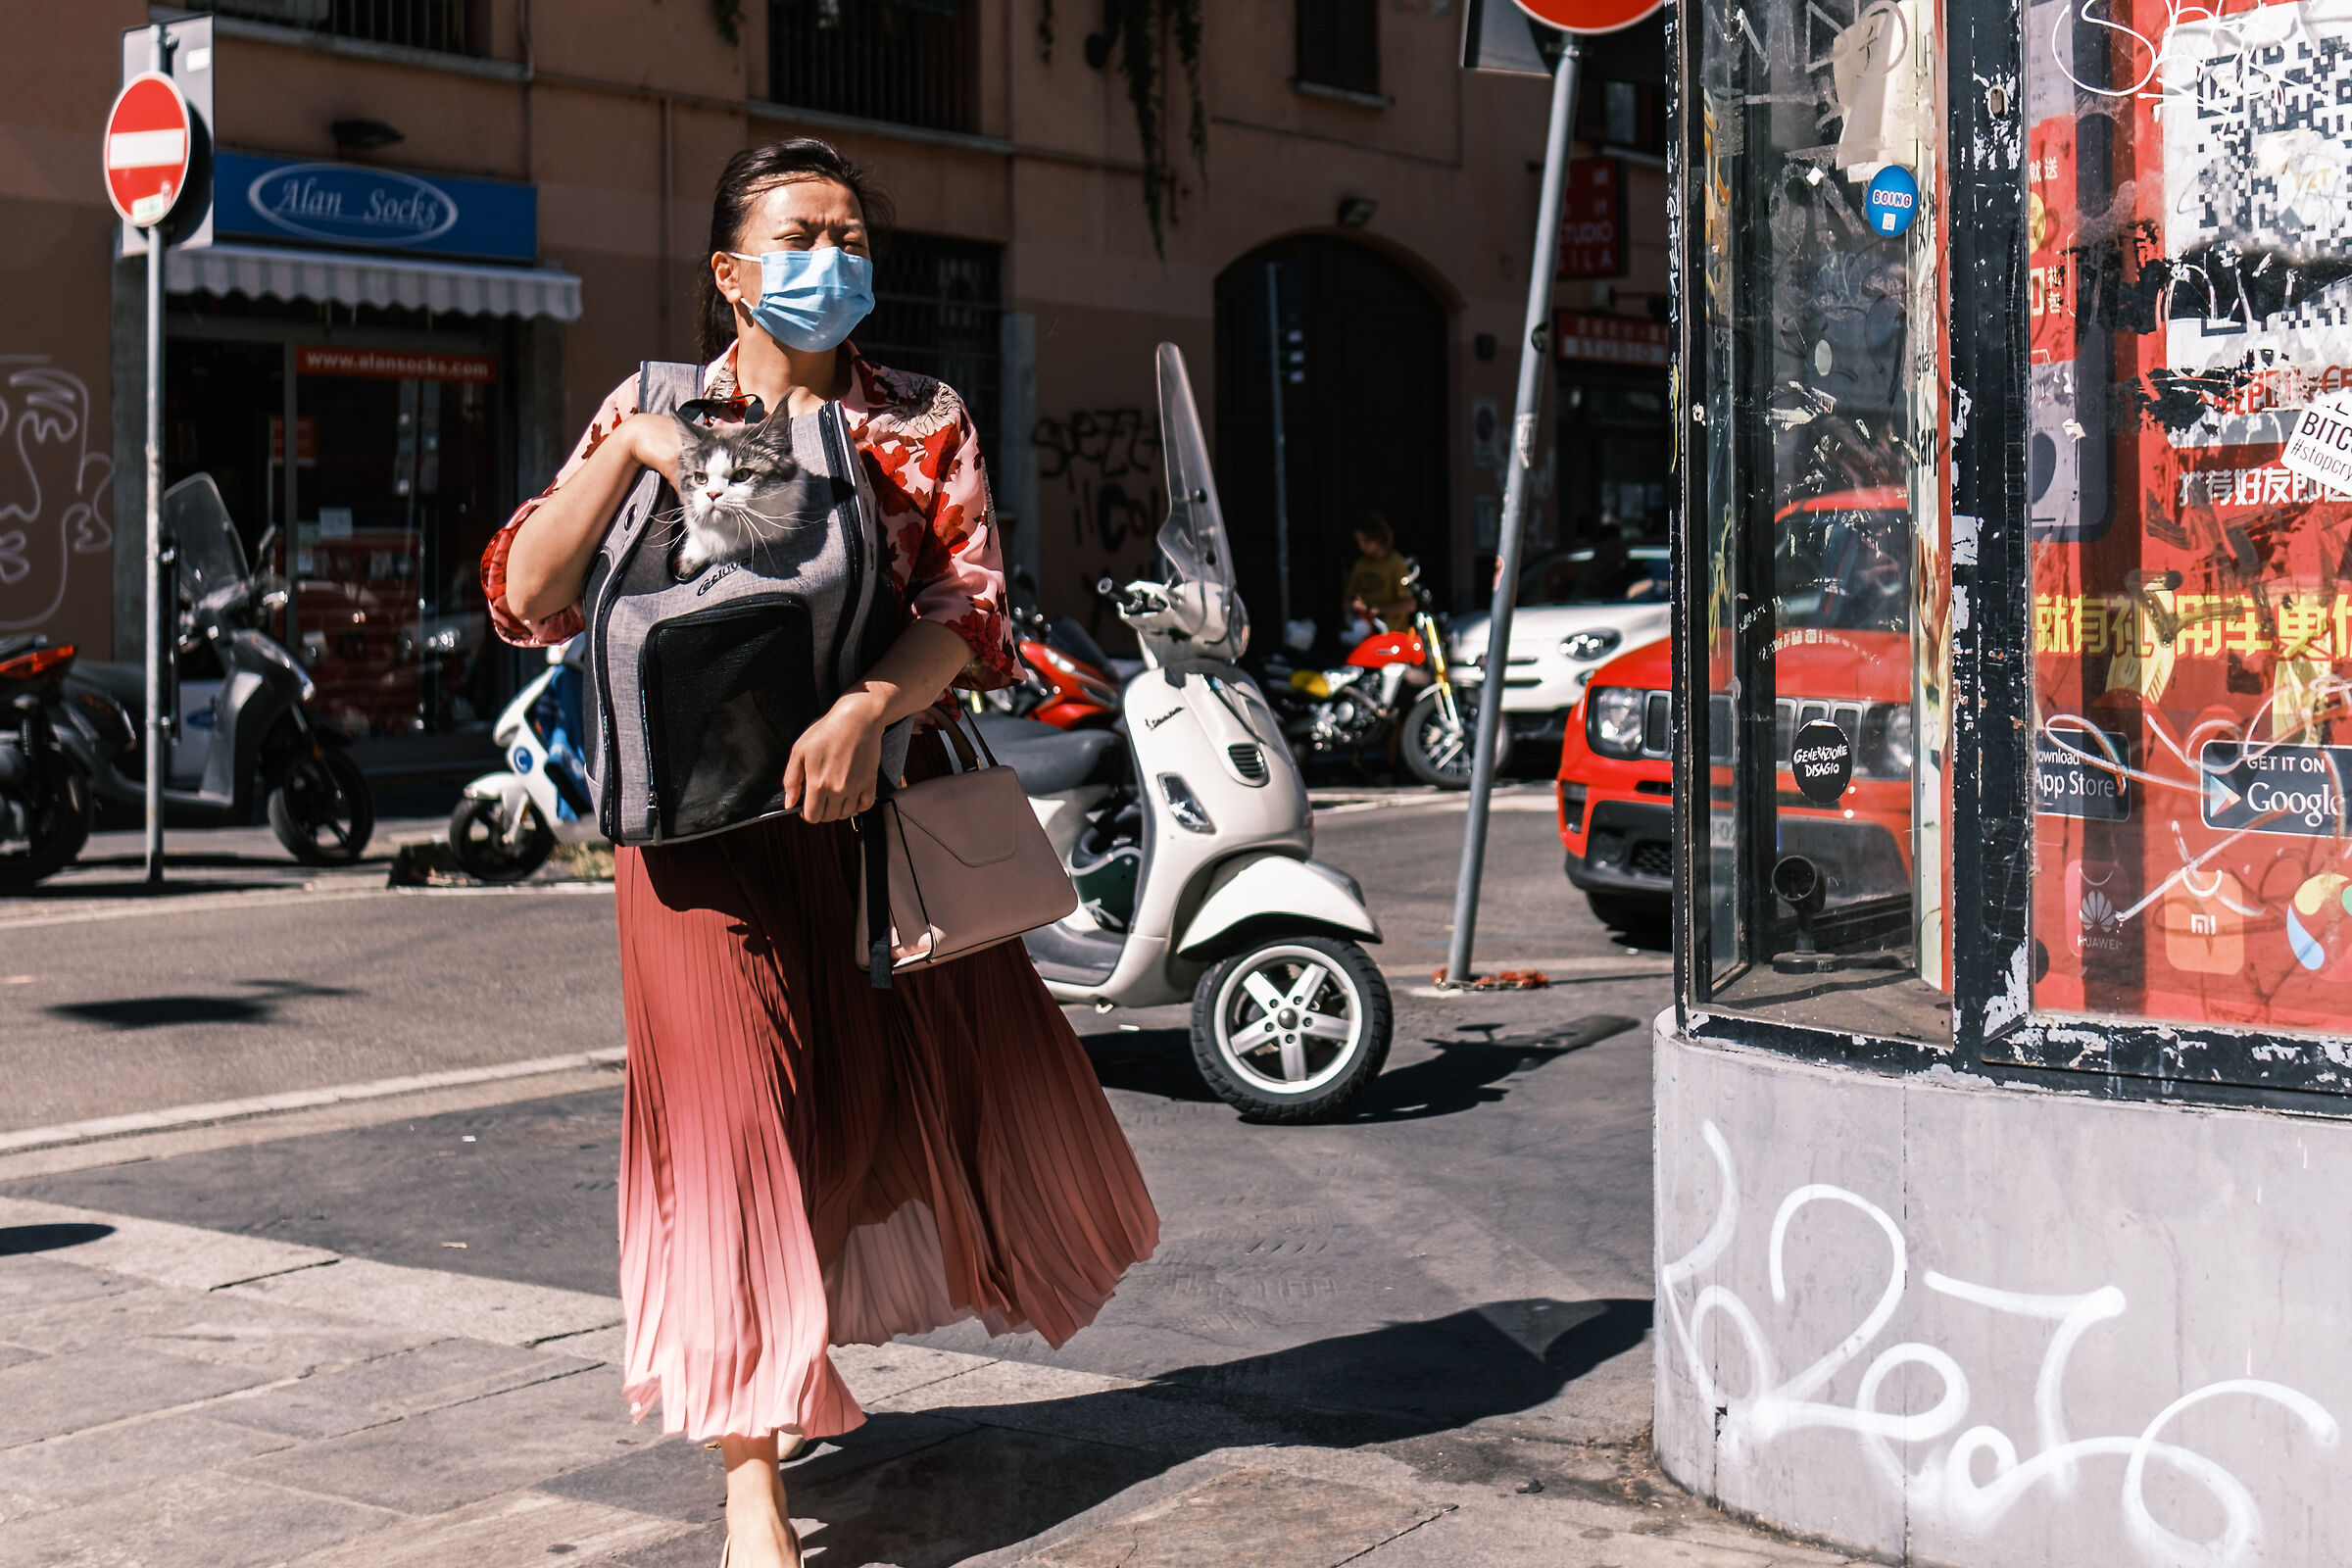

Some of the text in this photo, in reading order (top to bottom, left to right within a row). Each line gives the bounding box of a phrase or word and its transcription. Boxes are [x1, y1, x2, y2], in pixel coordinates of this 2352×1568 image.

[271, 175, 438, 232] Alan Socks
[306, 351, 488, 376] www.alansocks.com
[1793, 744, 1848, 764] GENERAZIONE
[1805, 762, 1839, 777] DISAGIO
[2246, 756, 2326, 773] GET IT ON
[2035, 767, 2114, 800] App Store
[2078, 934, 2119, 951] HUAWEI
